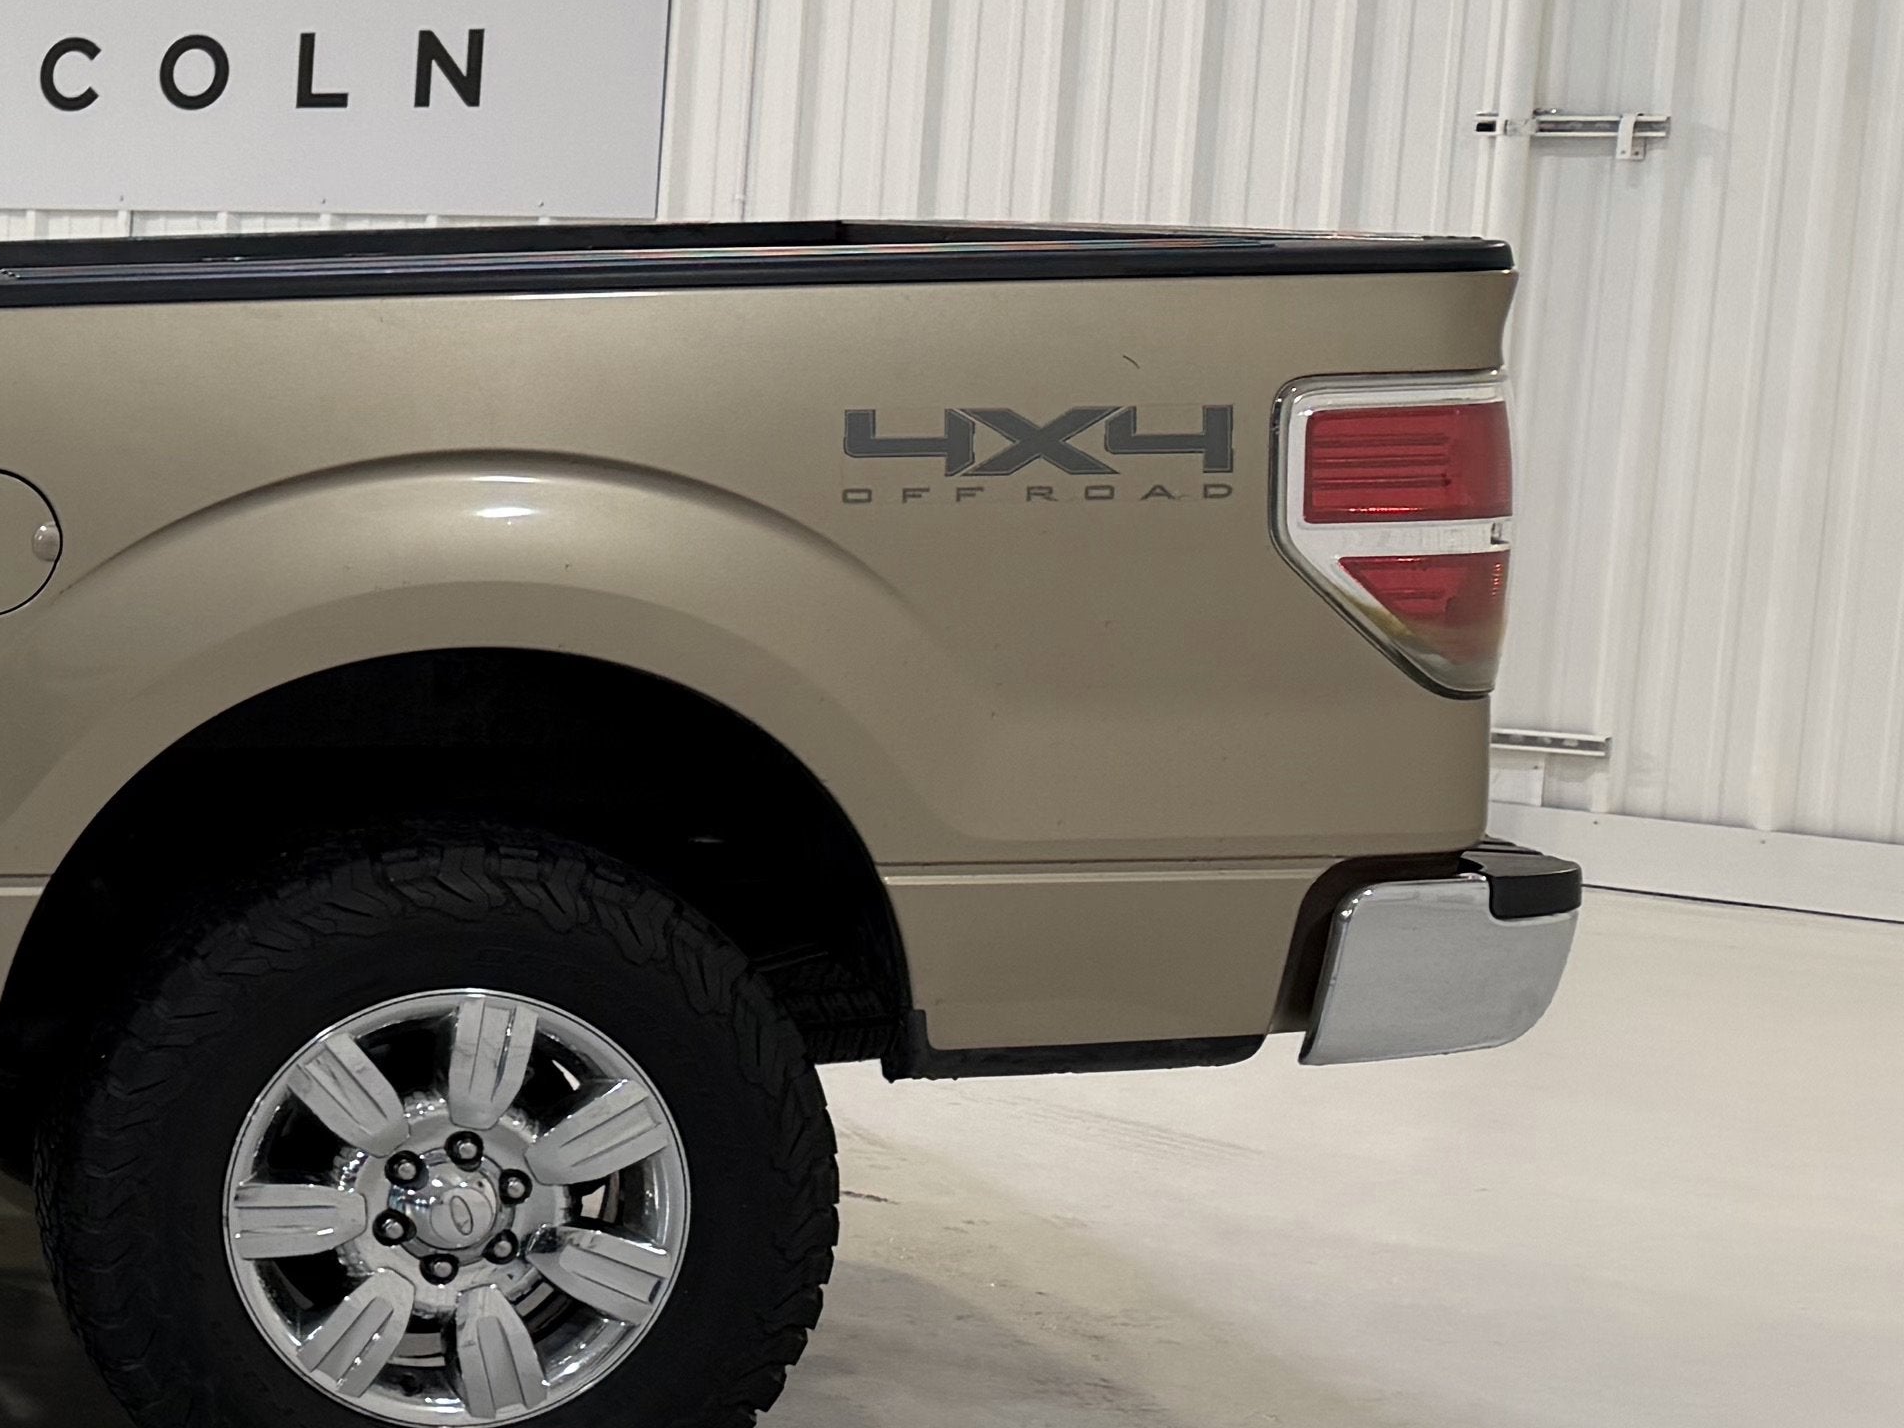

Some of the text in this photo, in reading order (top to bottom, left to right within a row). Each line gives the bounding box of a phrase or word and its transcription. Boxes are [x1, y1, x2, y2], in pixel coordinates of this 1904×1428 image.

[843, 404, 1234, 477] 4X4
[841, 483, 1234, 504] OFF ROAD
